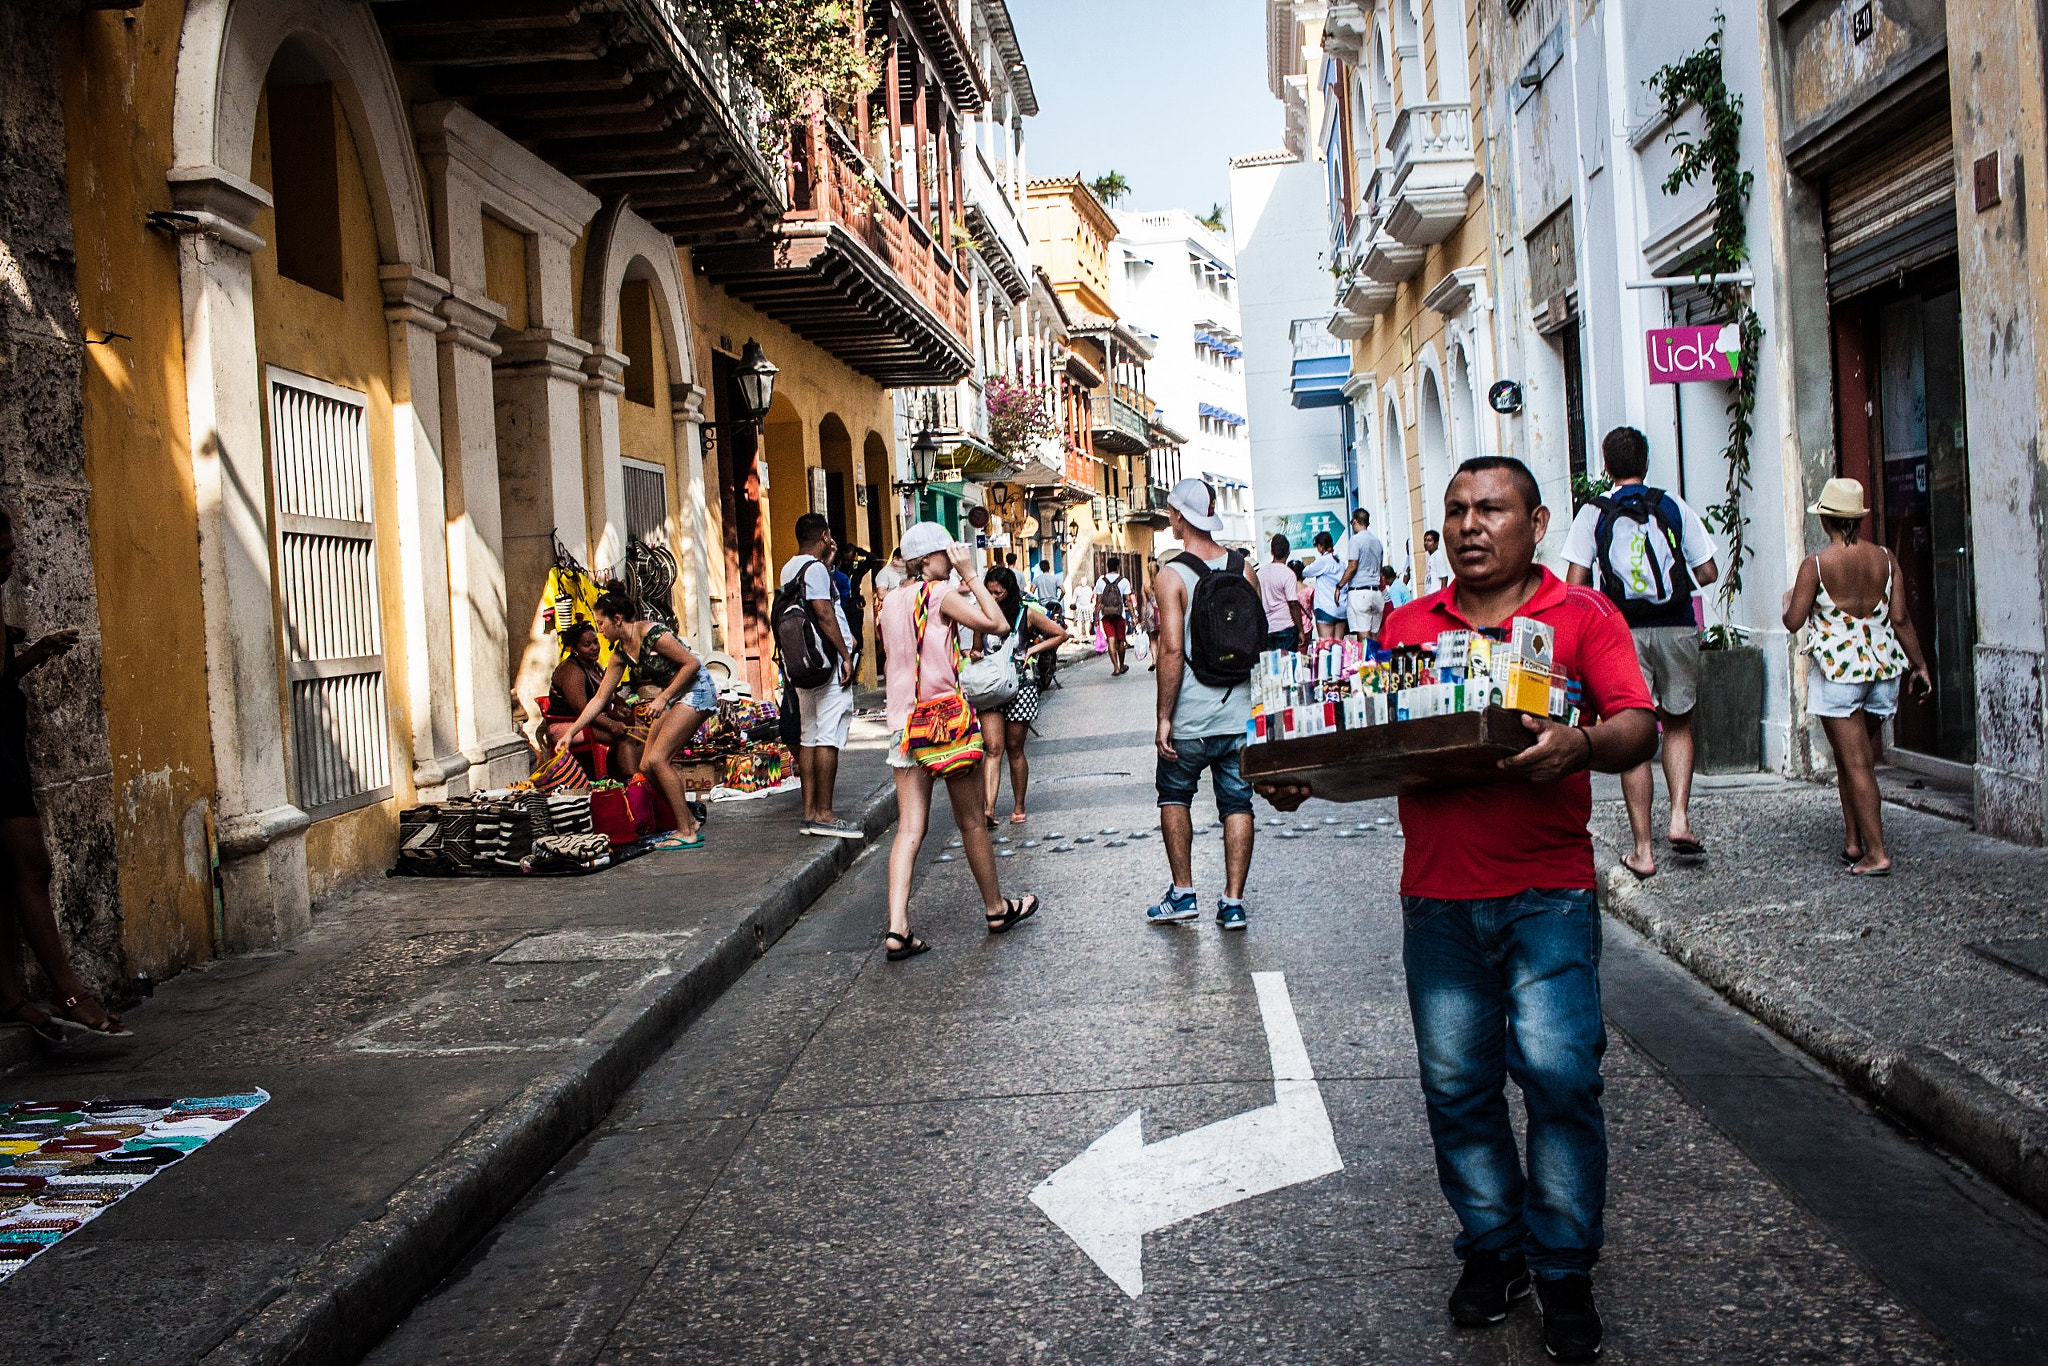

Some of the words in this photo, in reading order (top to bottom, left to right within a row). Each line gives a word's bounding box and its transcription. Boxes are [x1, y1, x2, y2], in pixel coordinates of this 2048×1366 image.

[1855, 8, 1870, 38] 5-10
[1651, 331, 1716, 373] Lick
[1322, 485, 1342, 497] SPA
[1630, 531, 1648, 593] OAKLEY
[685, 778, 712, 789] Dole
